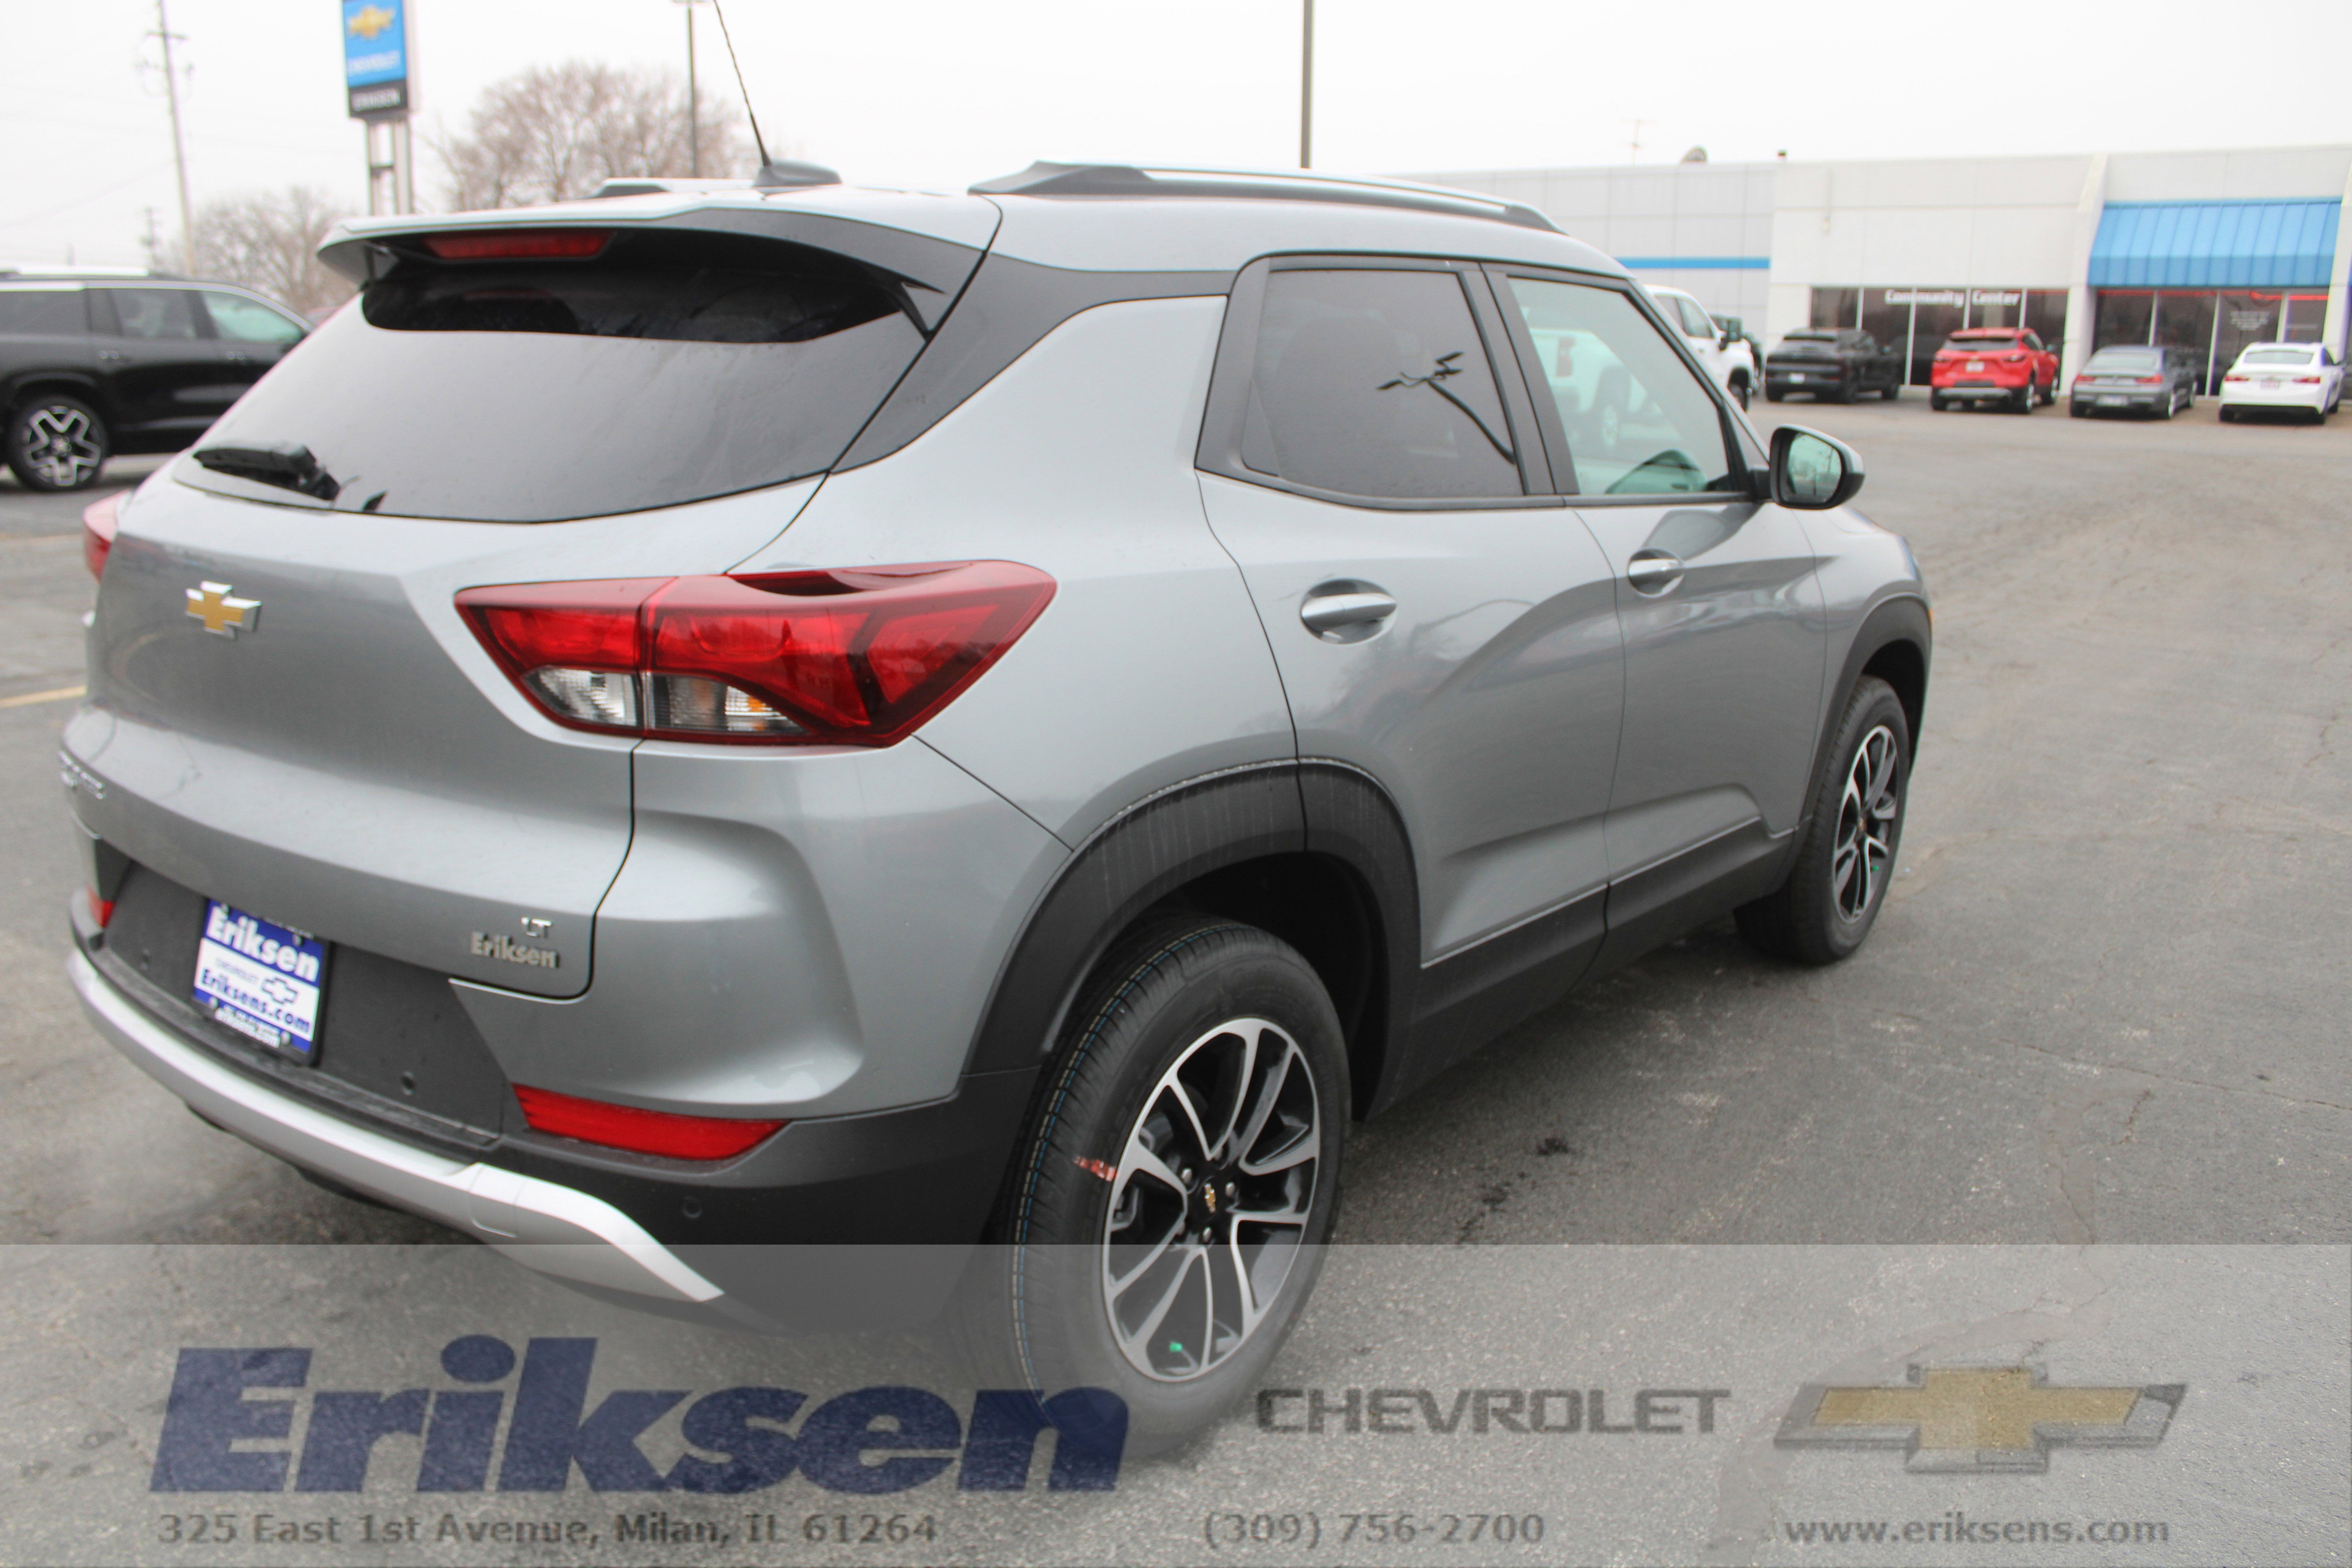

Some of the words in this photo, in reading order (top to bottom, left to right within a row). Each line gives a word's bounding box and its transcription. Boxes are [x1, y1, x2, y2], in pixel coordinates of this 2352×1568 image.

[1972, 289, 2021, 306] Center
[206, 906, 320, 982] Eriksen
[521, 917, 552, 938] LT
[471, 931, 561, 969] Eriksen
[203, 969, 310, 1032] Eriksens.com
